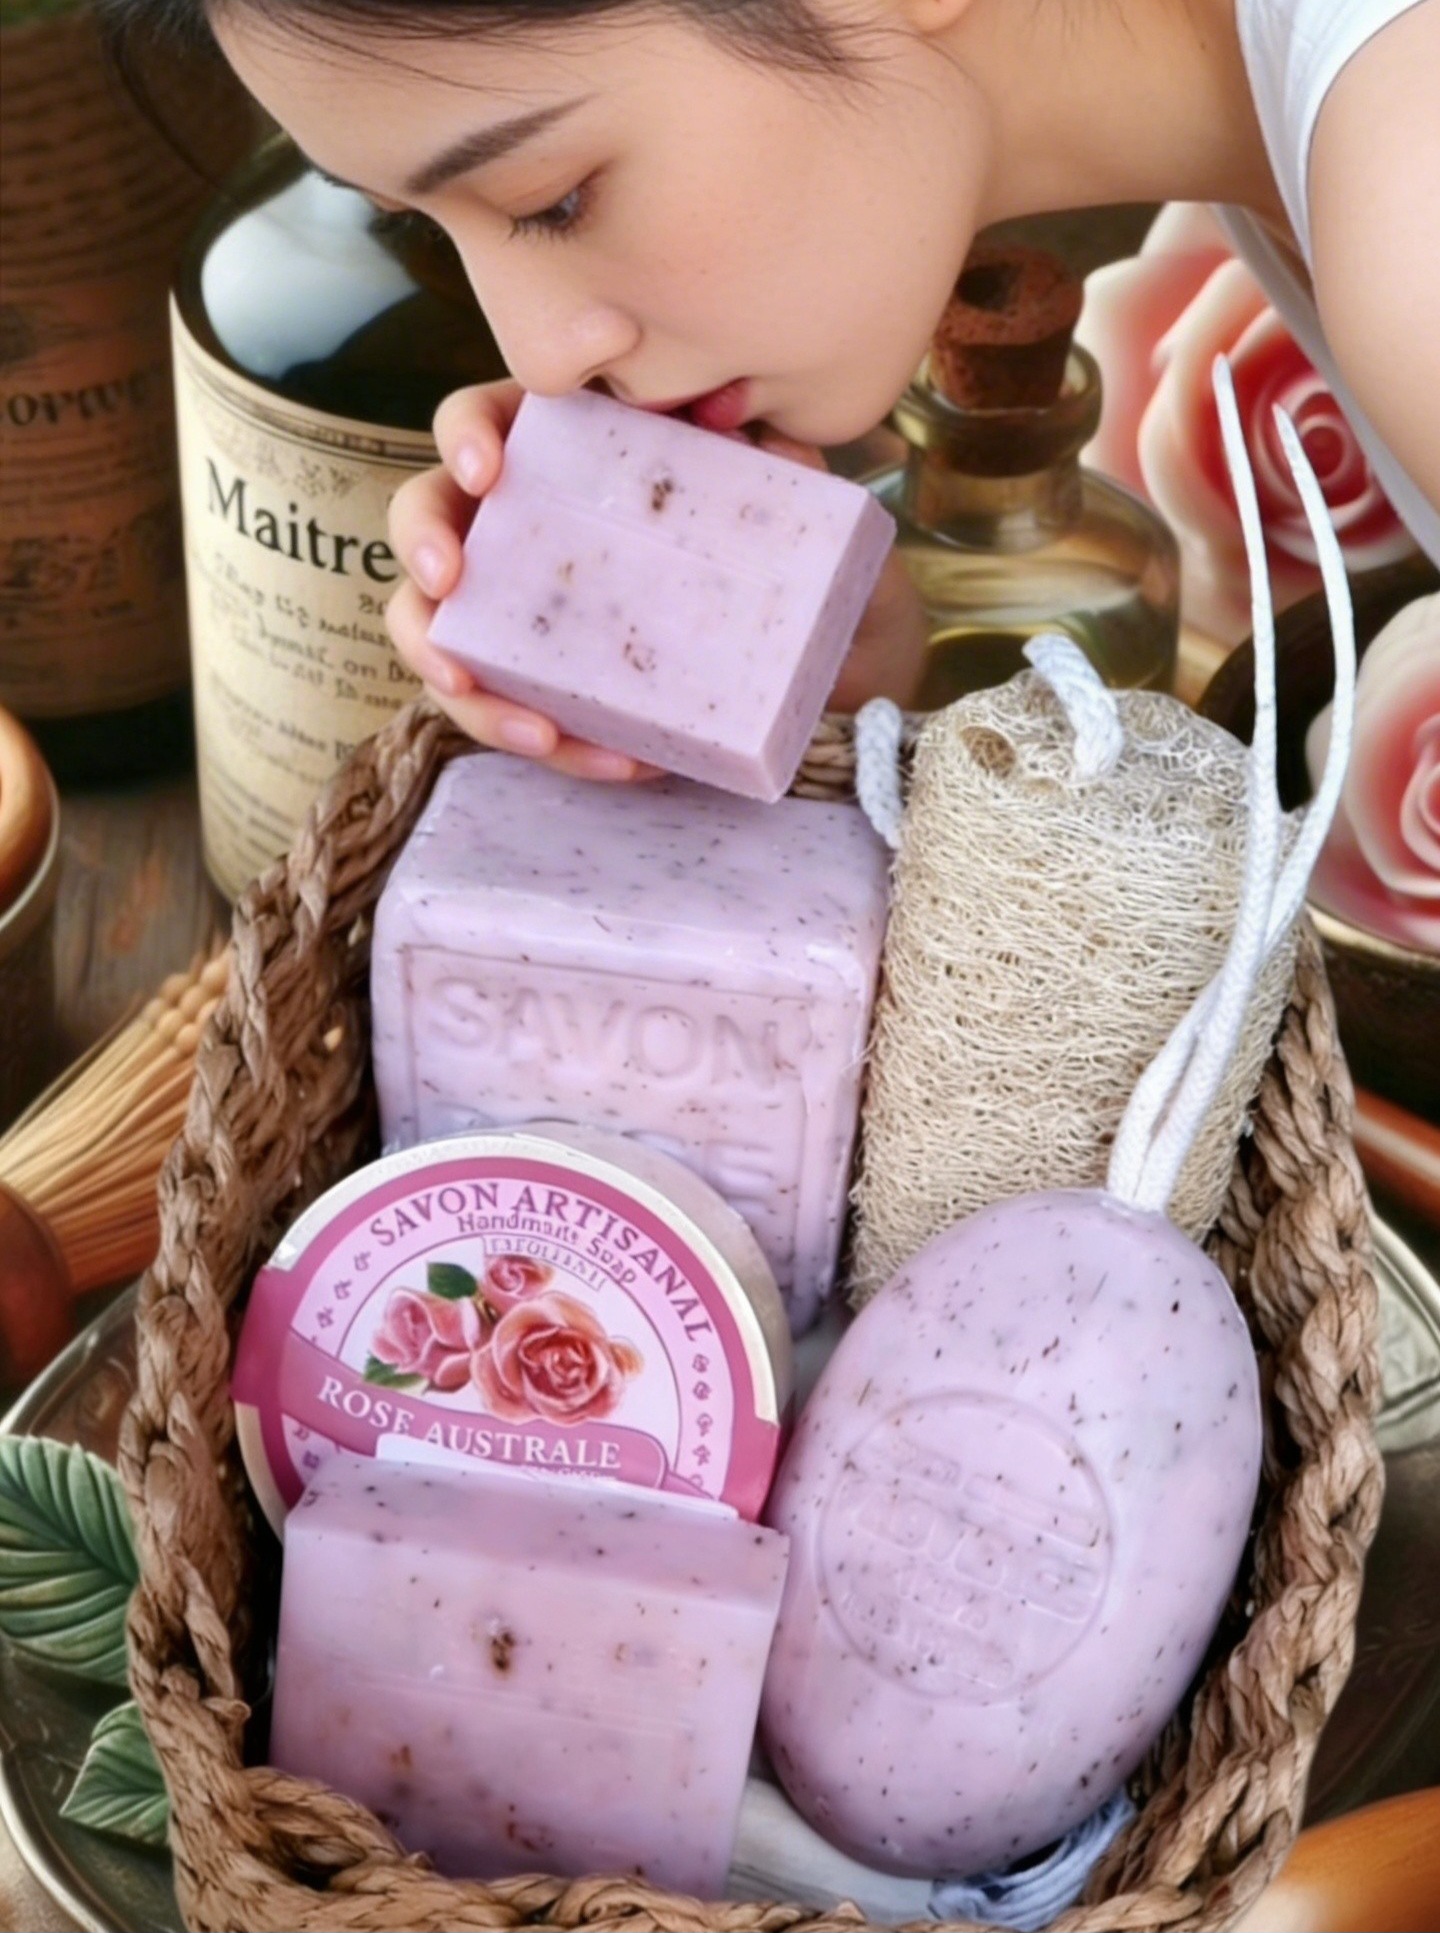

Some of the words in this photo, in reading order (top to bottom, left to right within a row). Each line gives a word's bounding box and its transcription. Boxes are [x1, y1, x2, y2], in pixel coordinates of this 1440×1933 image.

[205, 456, 398, 583] Maitre
[428, 976, 779, 1090] SAVON
[369, 1182, 499, 1248] SAVON
[510, 1184, 713, 1344] ARTISANAL
[317, 1374, 416, 1435] ROSE
[422, 1420, 622, 1470] AUSTRALE
